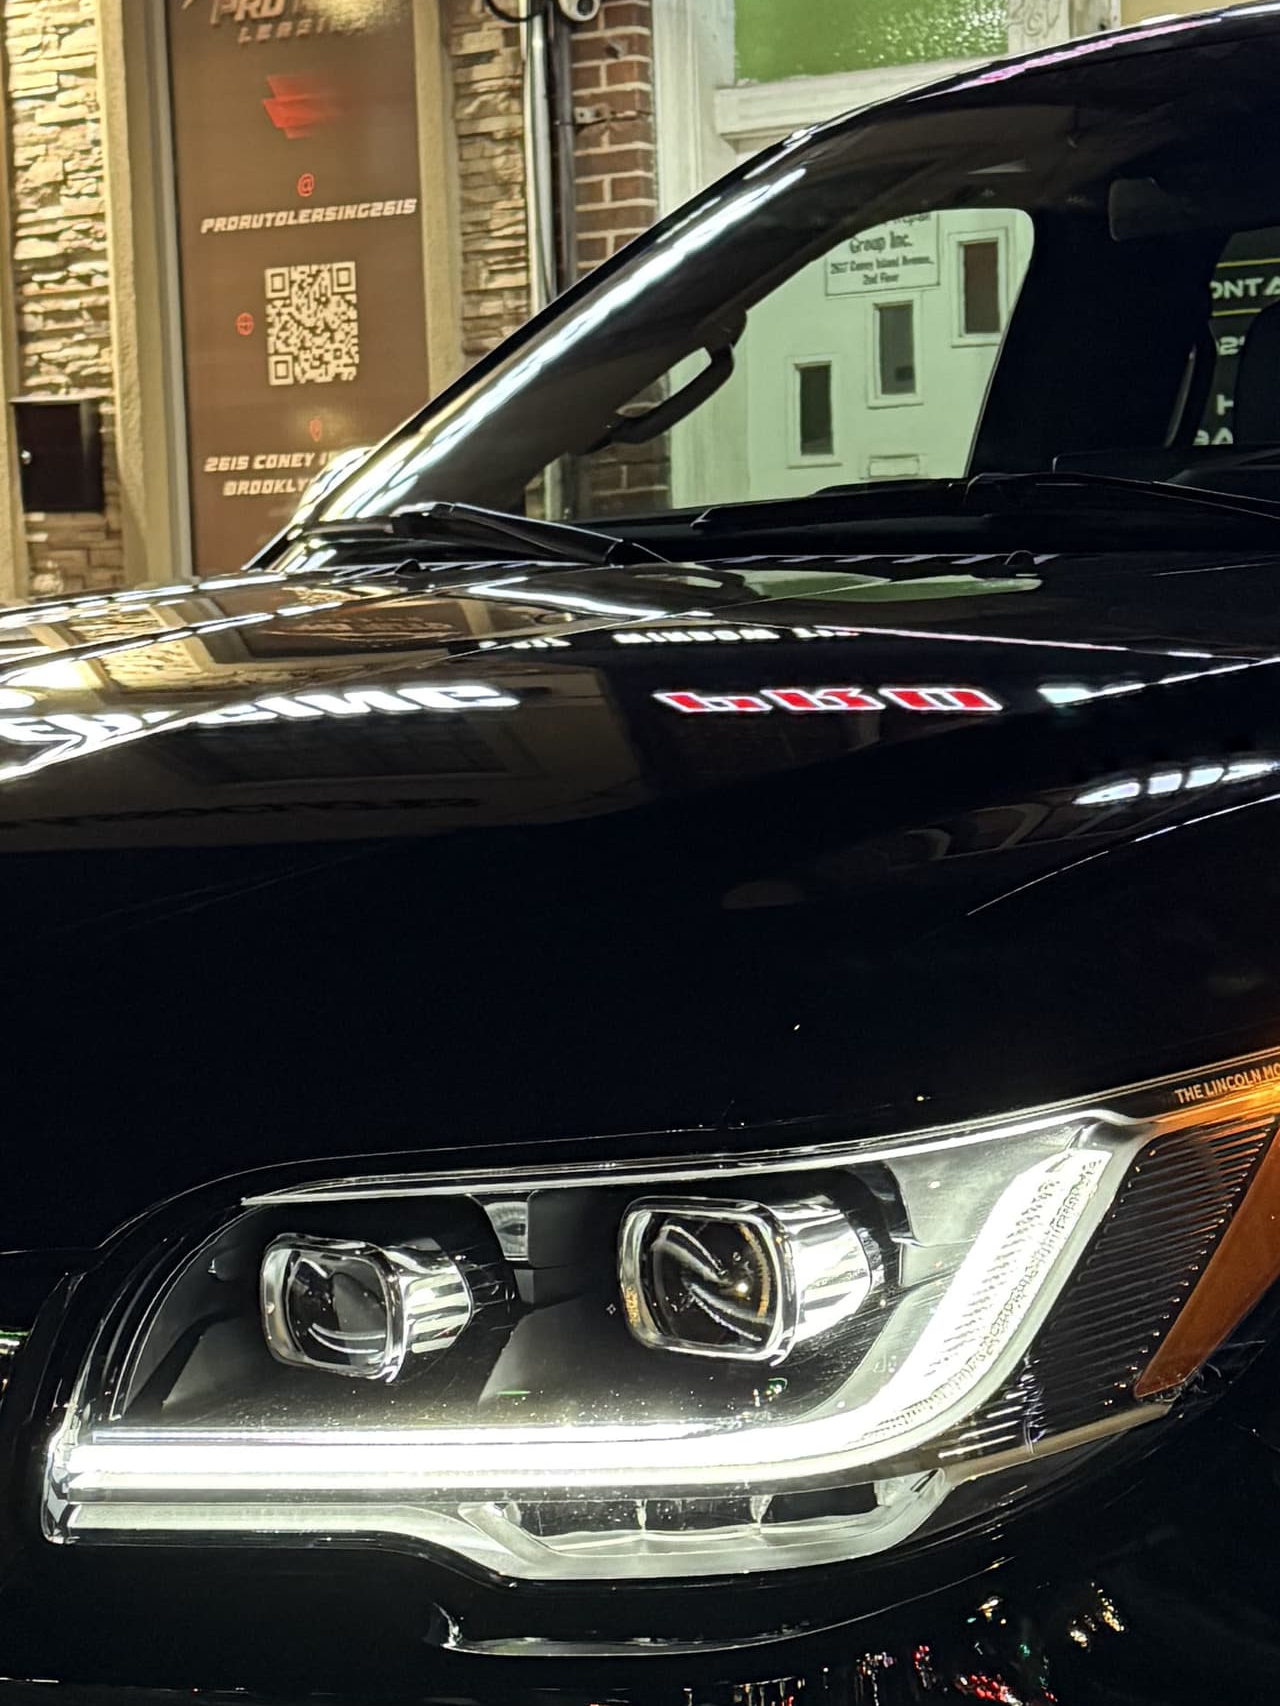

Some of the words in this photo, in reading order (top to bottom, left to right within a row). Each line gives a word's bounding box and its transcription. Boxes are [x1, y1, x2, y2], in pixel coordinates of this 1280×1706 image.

[200, 197, 418, 235] PROAUTOLEASING2615
[203, 454, 250, 474] 2615
[253, 451, 316, 471] CONEY
[1174, 1083, 1205, 1105] THE
[1206, 1068, 1262, 1097] LINCOLN
